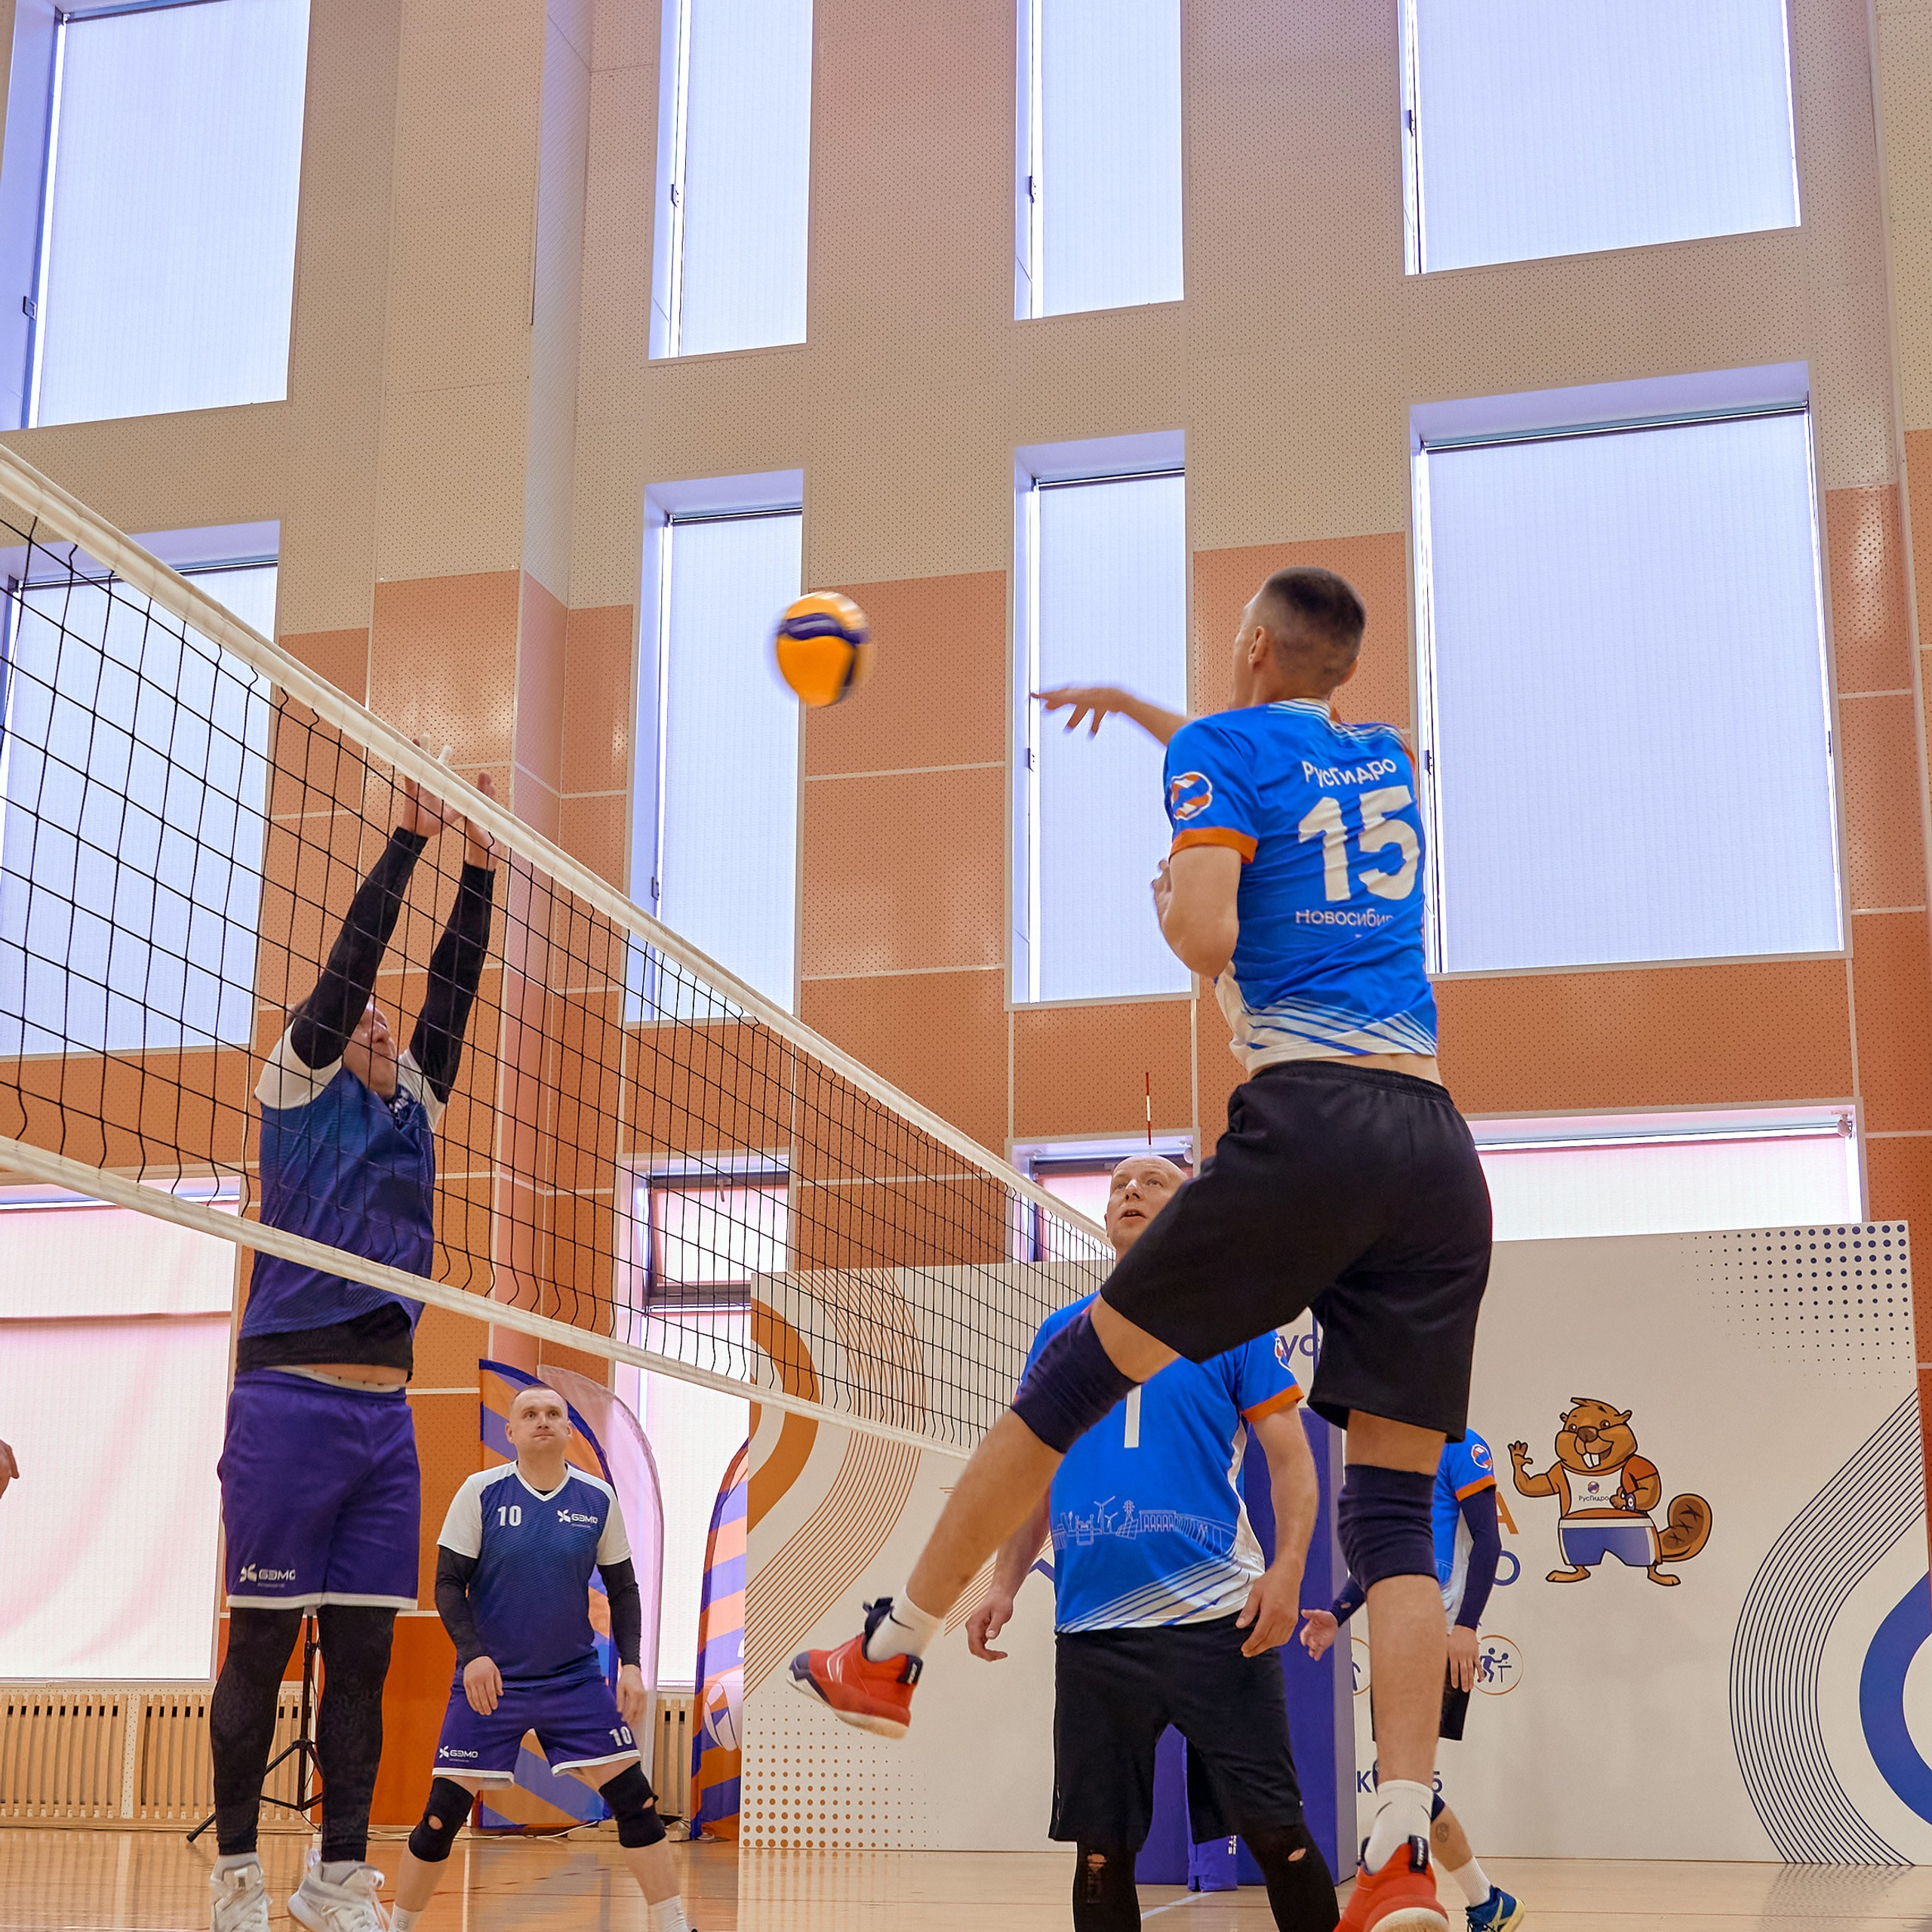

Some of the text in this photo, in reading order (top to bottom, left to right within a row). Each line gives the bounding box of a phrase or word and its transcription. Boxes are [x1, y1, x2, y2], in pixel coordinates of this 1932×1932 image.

[1298, 785, 1420, 901] 15
[497, 1505, 522, 1527] 10
[609, 1726, 633, 1747] 10
